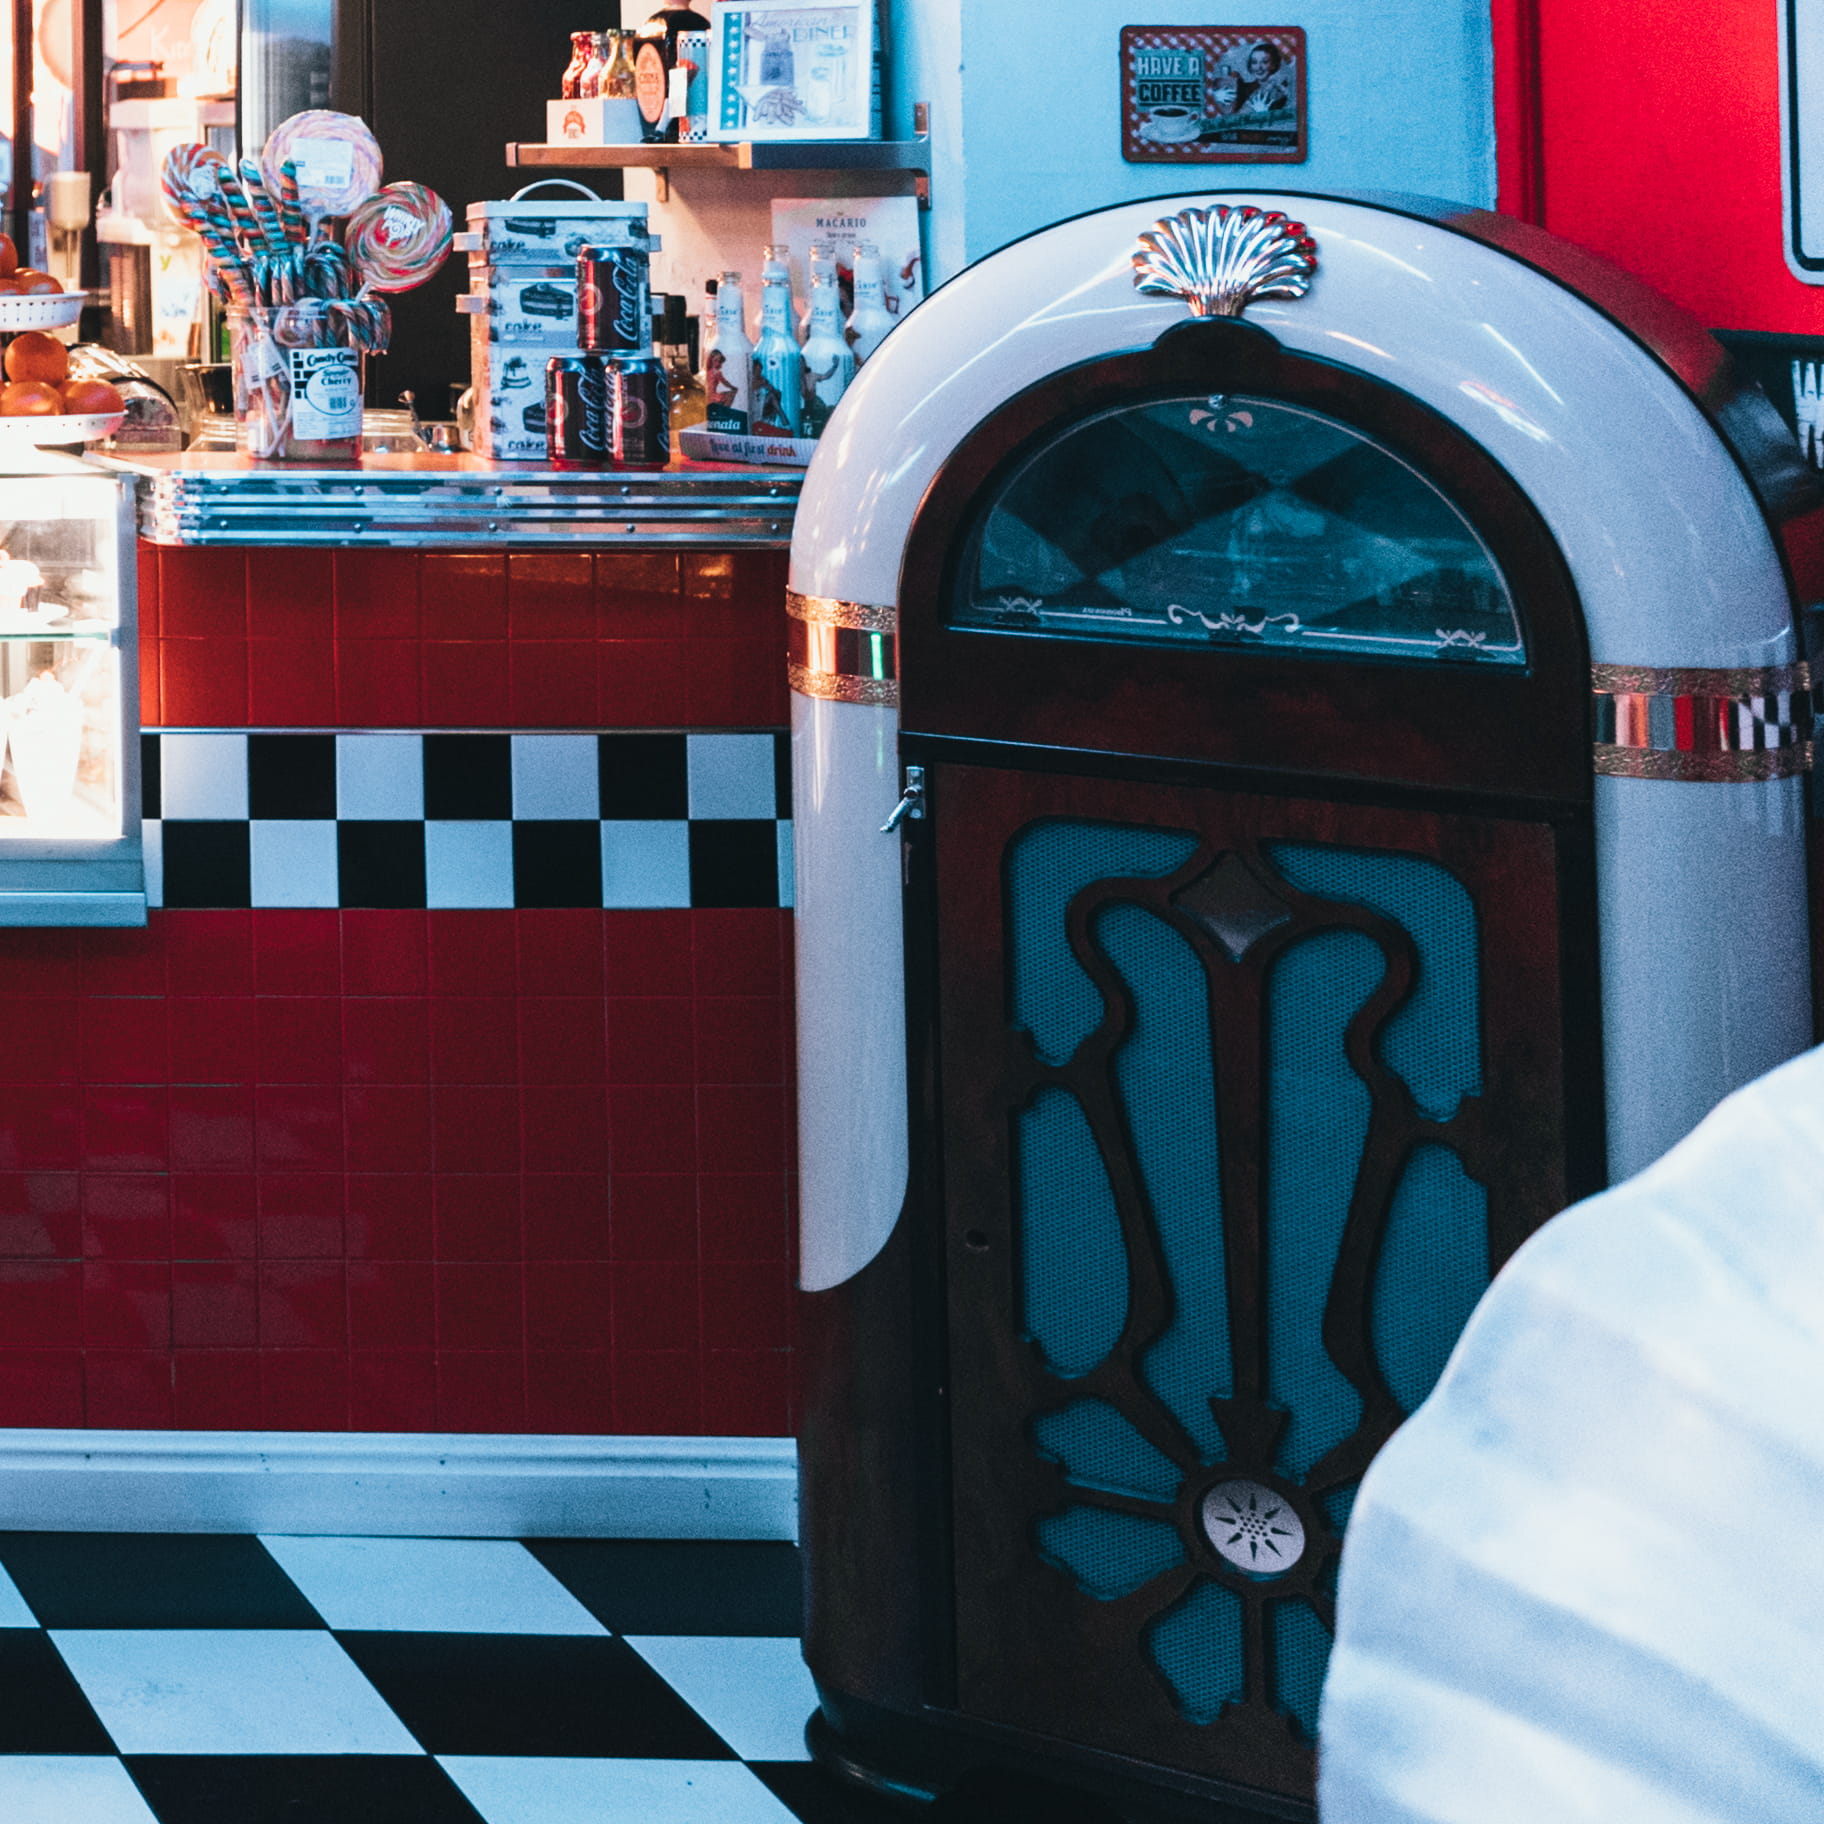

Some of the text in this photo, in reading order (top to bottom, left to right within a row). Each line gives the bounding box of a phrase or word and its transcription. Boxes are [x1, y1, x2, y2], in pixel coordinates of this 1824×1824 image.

[1137, 56, 1200, 76] HAVE A
[1139, 83, 1201, 102] COFFEE
[816, 217, 867, 228] MACARIO
[320, 377, 352, 386] Cherry
